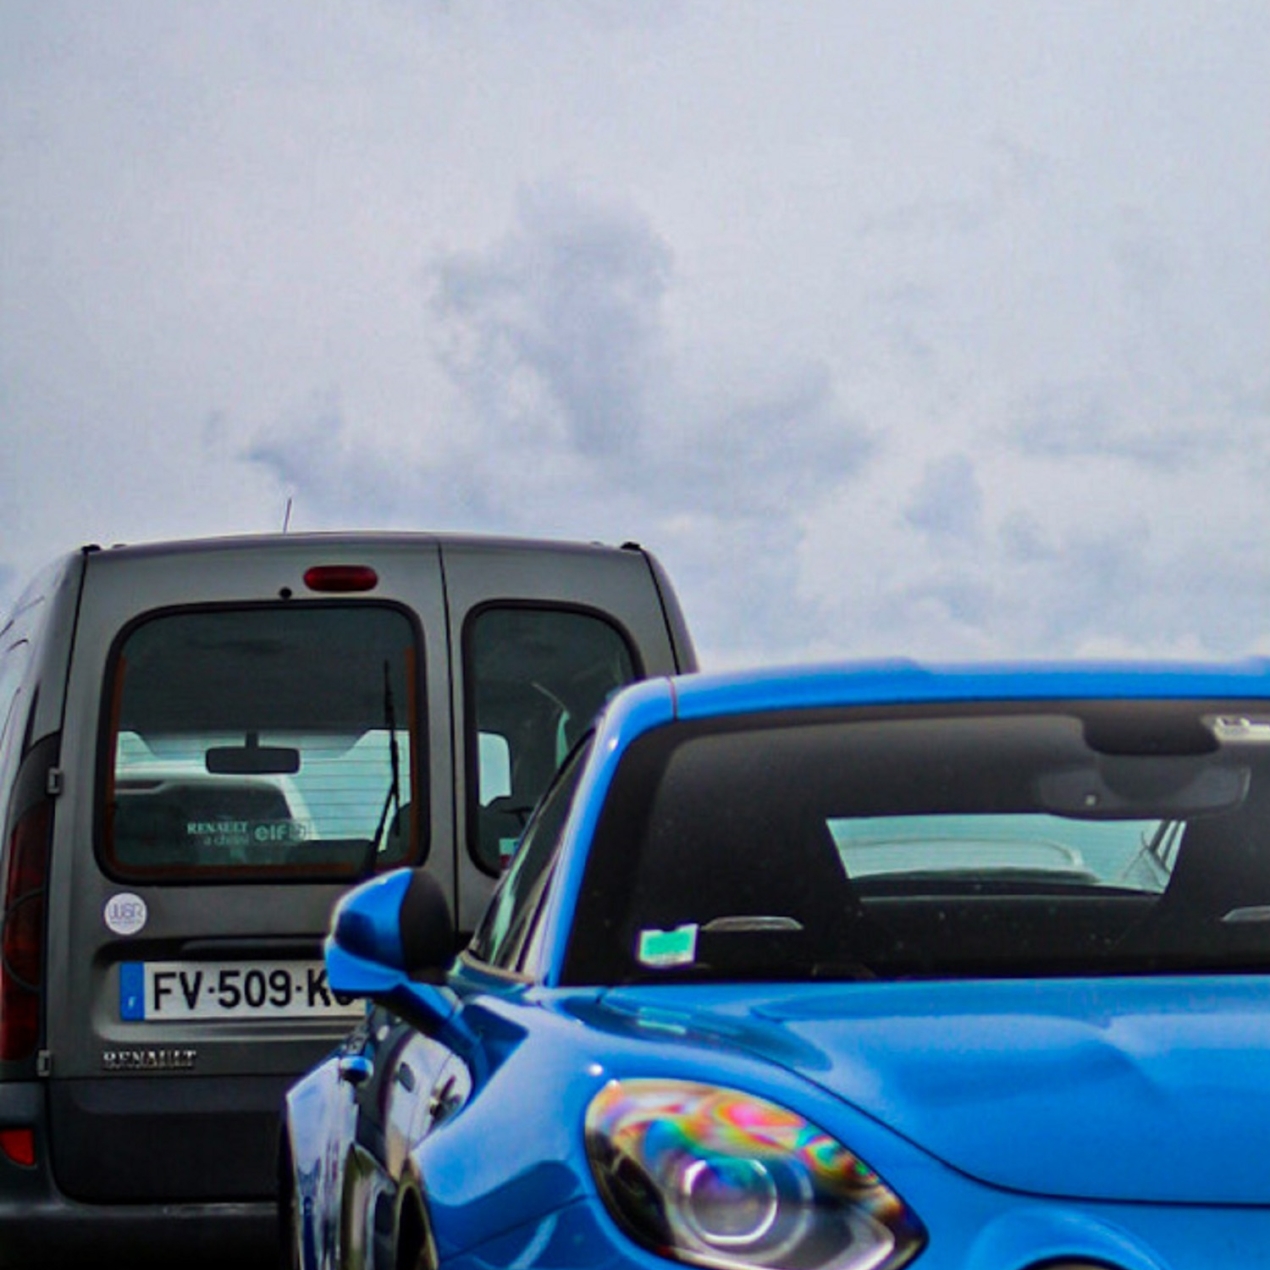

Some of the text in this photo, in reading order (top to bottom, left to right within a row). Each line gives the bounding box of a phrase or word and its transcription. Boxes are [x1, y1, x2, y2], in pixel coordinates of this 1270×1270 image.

[255, 824, 287, 841] elf
[153, 969, 352, 1010] FV-509-K
[103, 1050, 197, 1068] RENAULT
